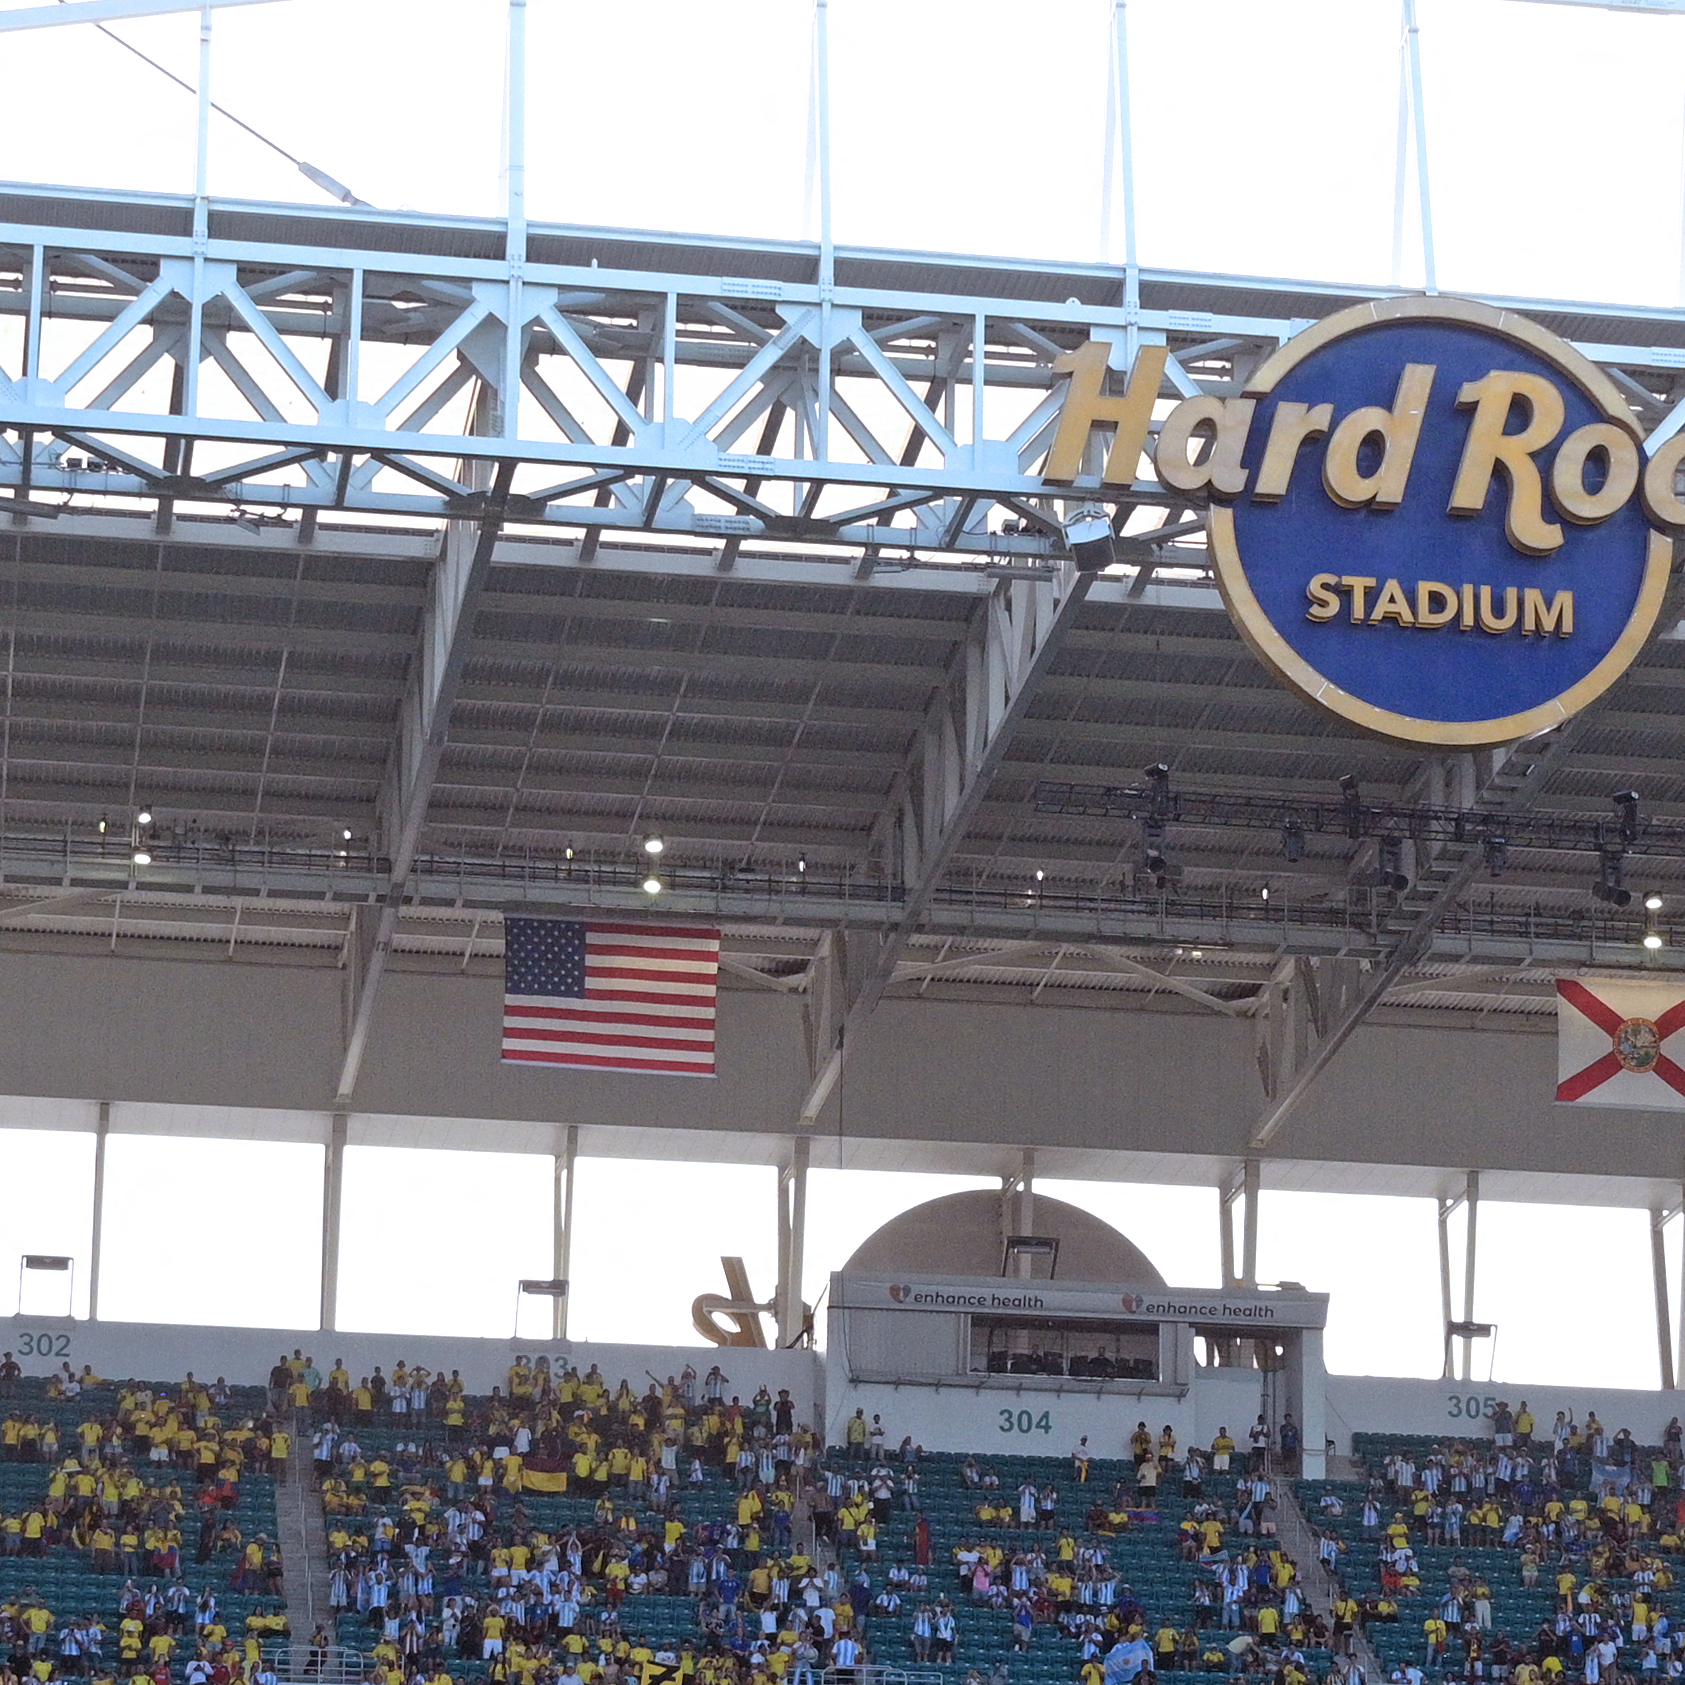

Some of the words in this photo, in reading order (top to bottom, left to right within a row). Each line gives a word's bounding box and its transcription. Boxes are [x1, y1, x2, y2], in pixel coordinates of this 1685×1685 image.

[1042, 341, 1436, 511] Hard
[1304, 572, 1575, 639] STADIUM
[914, 1291, 986, 1307] enhance
[991, 1292, 1044, 1310] health
[1145, 1302, 1216, 1316] enhance
[1222, 1302, 1274, 1320] health
[17, 1332, 71, 1358] 302
[1447, 1396, 1496, 1420] 305
[998, 1410, 1052, 1435] 304
